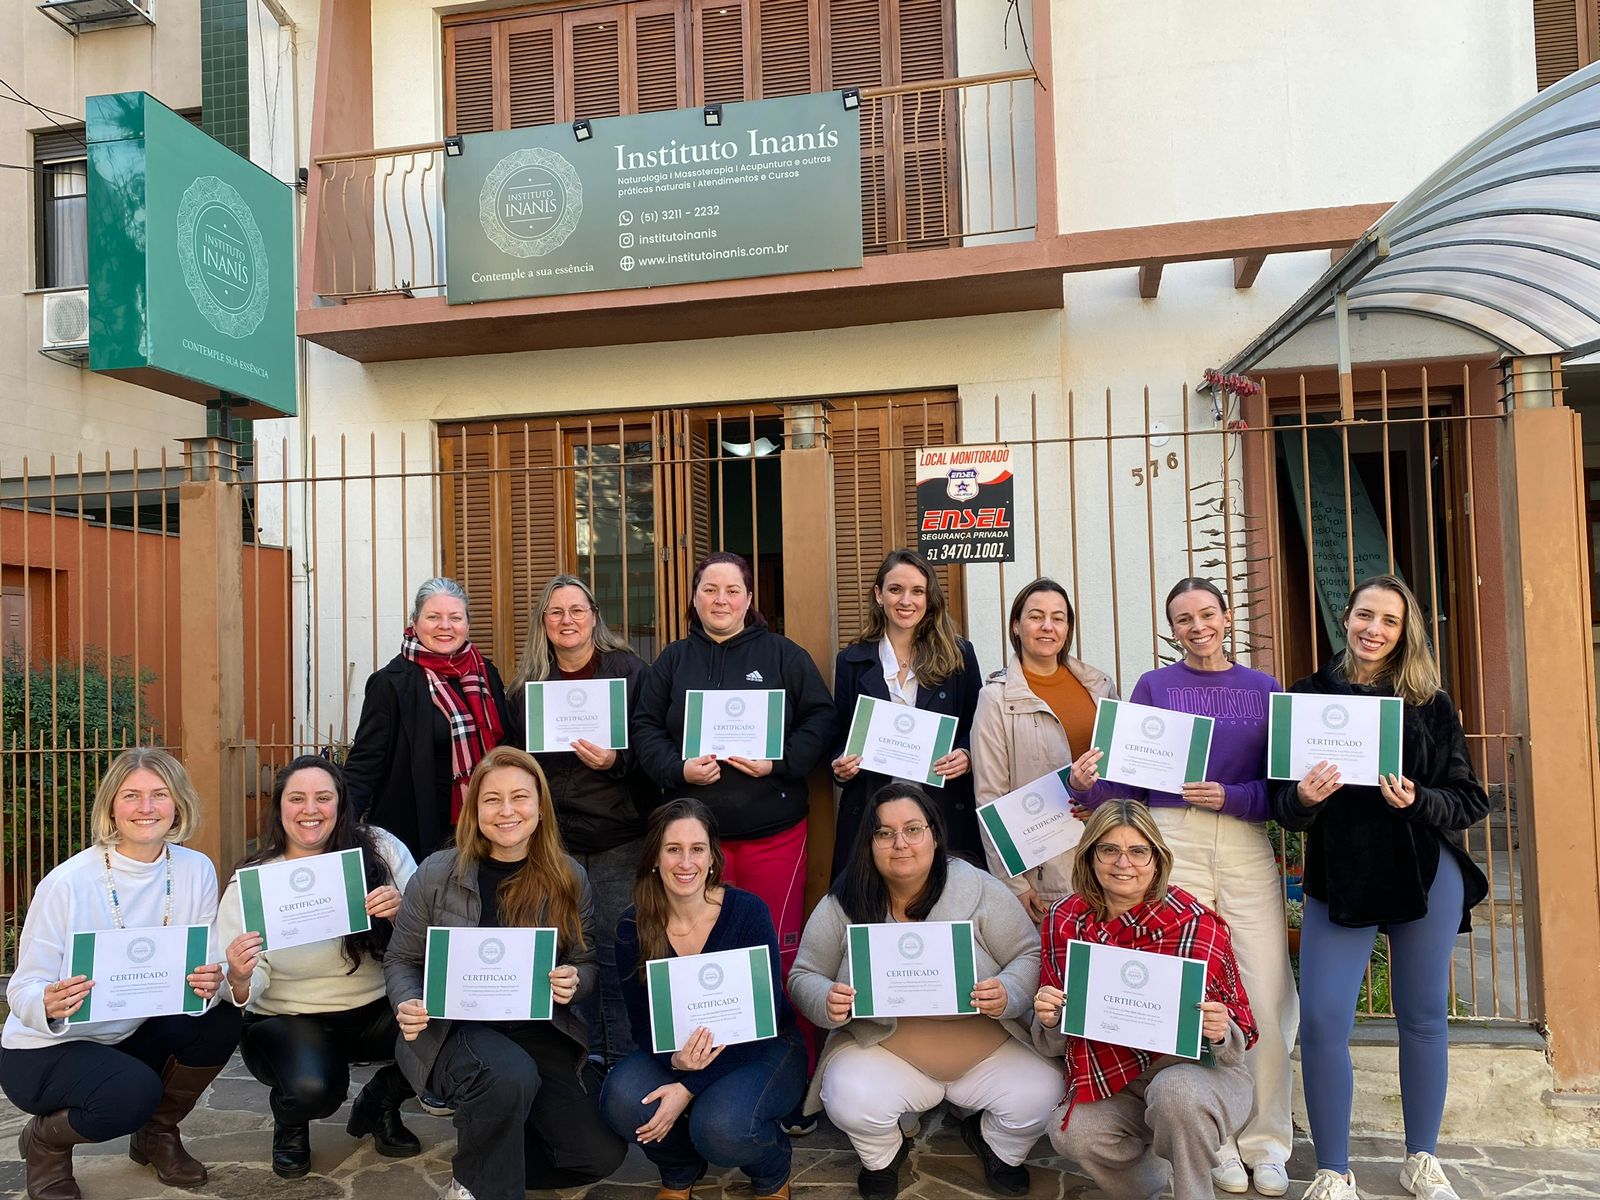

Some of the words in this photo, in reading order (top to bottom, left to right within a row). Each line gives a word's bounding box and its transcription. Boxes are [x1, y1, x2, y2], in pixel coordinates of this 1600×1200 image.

[614, 139, 738, 171] Instituto
[746, 123, 839, 157] Inanís
[617, 172, 668, 185] Naturologia
[674, 165, 734, 179] Massoterapia
[740, 160, 793, 172] Acupuntura
[802, 155, 832, 165] outras
[618, 185, 654, 198] práticas
[655, 180, 691, 192] naturais
[697, 173, 759, 188] Atendimentos
[768, 170, 800, 180] Cursos
[508, 189, 554, 202] INSTITUTO
[505, 197, 557, 217] INANÍS
[640, 210, 659, 224] (51)
[661, 209, 682, 221] 3211
[694, 205, 720, 217] 2232
[639, 228, 717, 245] institutoinanis
[205, 232, 246, 262] INSTITUTO
[638, 243, 789, 266] www.institutoinanis.com.br
[202, 245, 249, 285] INANÍS
[471, 268, 526, 283] Contemple
[527, 270, 534, 278] a
[536, 268, 552, 277] sua
[554, 262, 594, 275] essência
[182, 338, 225, 363] CONTEMPLE
[225, 355, 239, 368] SUA
[239, 361, 269, 379] ESSÊNCIA
[920, 452, 948, 467] LOCAL
[949, 448, 1010, 465] MONITORADO
[921, 507, 1011, 531] ENSEL
[921, 531, 972, 541] SEGURANÇA
[973, 530, 1009, 539] PRIVADA
[927, 548, 939, 560] 51
[940, 542, 1005, 560] 3470.1001
[556, 714, 599, 722] CERTIFICADO
[878, 736, 921, 751] CERTIFICADO
[1125, 743, 1175, 758] CERTIFICADO
[1306, 738, 1363, 748] CERTIFICADO
[1023, 812, 1065, 836] CERTIFICADO
[279, 896, 332, 913] CERTIFICADO
[110, 970, 169, 982] CERTIFICADO
[886, 969, 939, 978] CERTIFICADO
[687, 996, 739, 1011] CERTIFICADO
[1103, 994, 1162, 1011] CERTIFICADO
